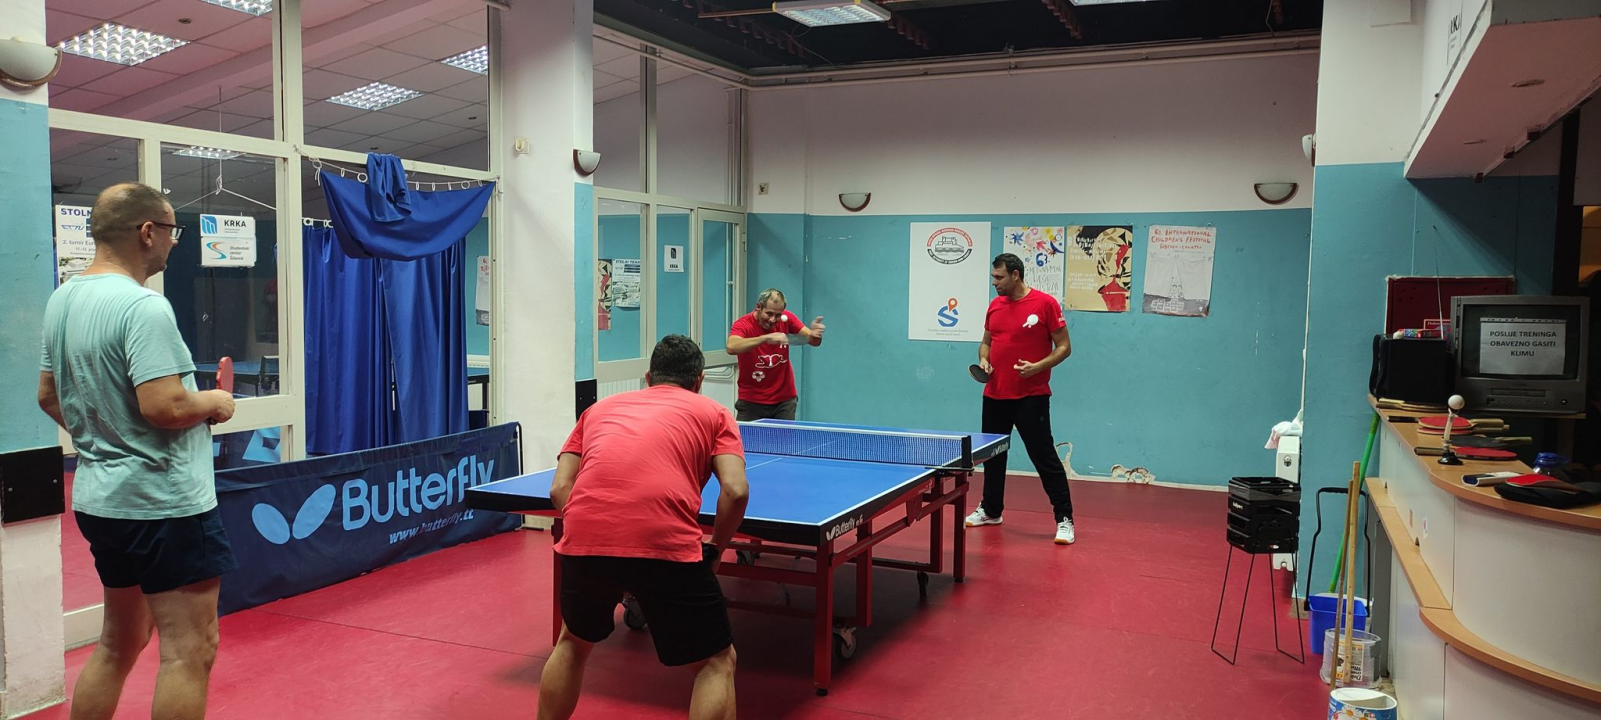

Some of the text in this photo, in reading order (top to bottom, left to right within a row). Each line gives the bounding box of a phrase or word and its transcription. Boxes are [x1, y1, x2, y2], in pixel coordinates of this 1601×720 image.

[61, 208, 93, 217] STOLN
[224, 219, 246, 227] KRKA
[1489, 330, 1518, 338] POSLIJE
[1489, 340, 1531, 348] OBAVEZNO
[1510, 350, 1535, 358] KLIMU
[342, 455, 495, 531] Butterfly
[835, 517, 856, 537] Butterfly
